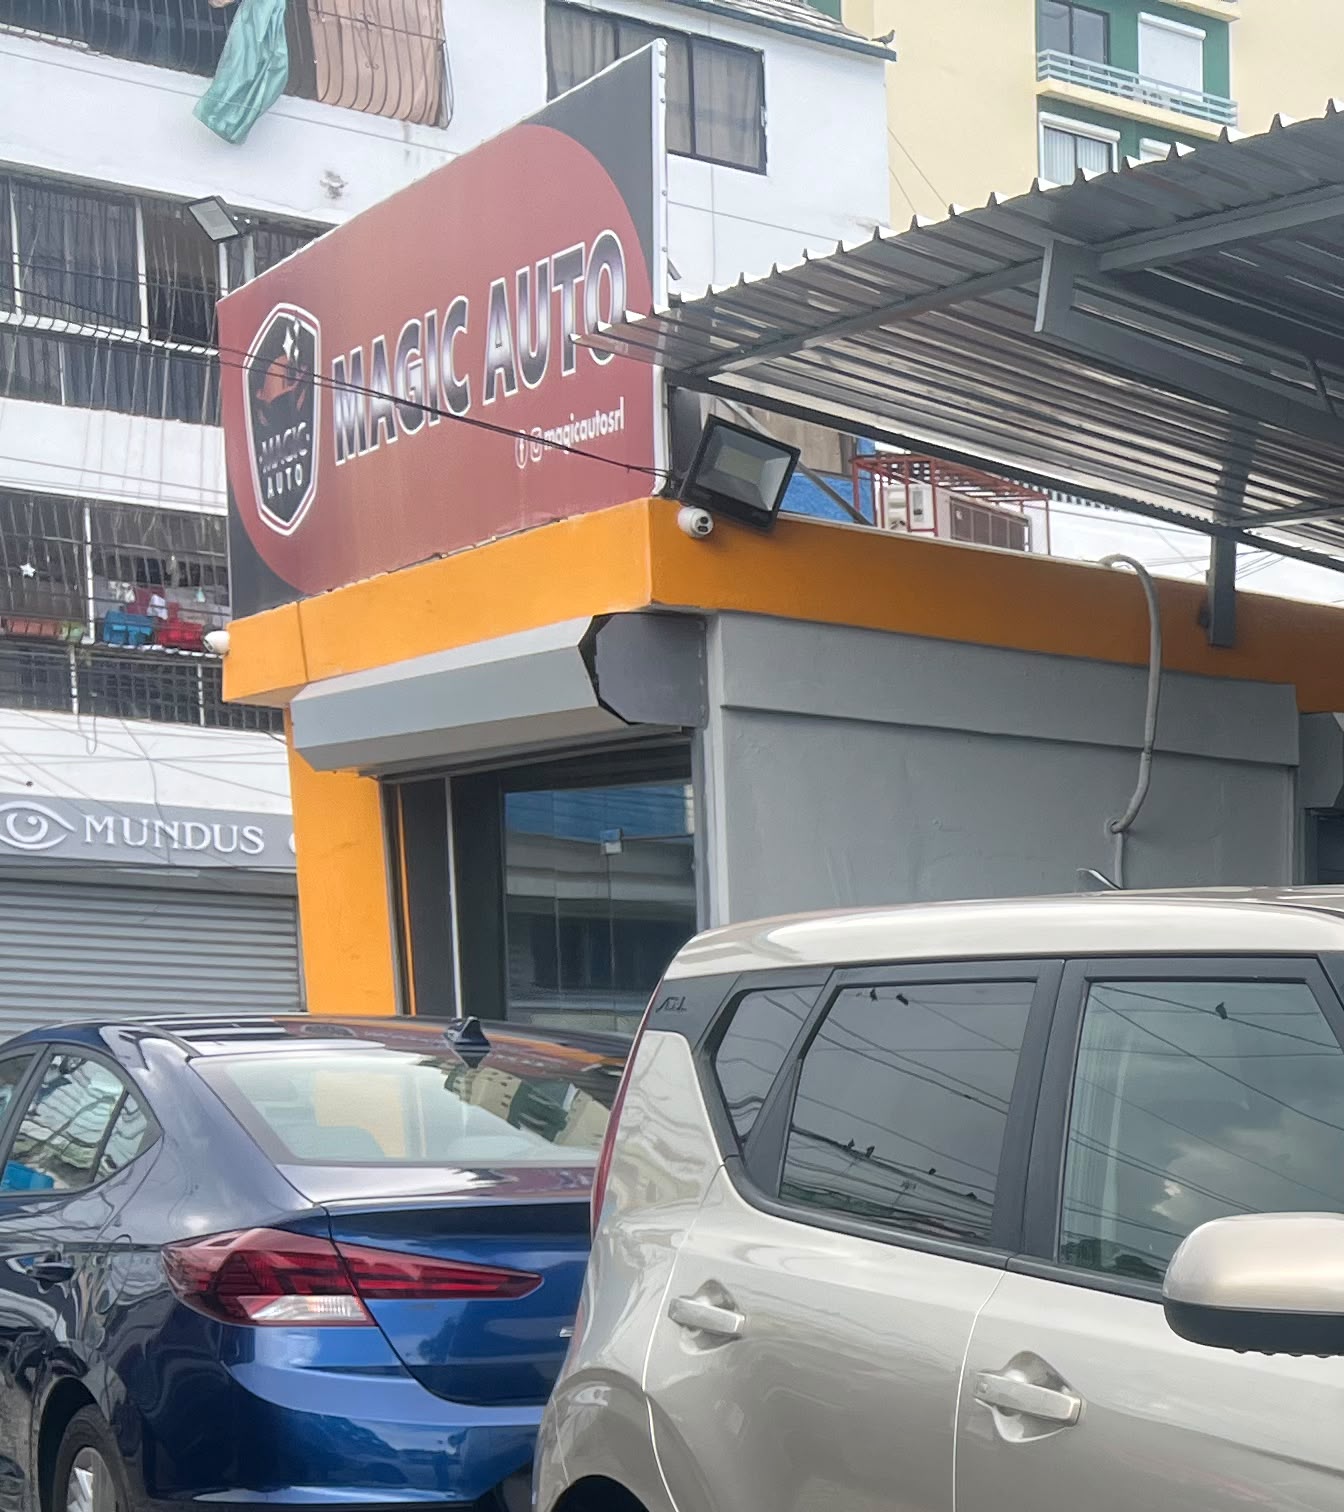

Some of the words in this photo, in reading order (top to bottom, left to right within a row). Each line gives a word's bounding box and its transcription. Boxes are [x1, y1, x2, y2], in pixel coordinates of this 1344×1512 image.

[332, 295, 471, 466] MAGIC
[483, 229, 627, 406] AUTO
[543, 395, 625, 455] magicautosrl
[267, 463, 303, 499] AUTO
[82, 814, 266, 855] MUNDUS
